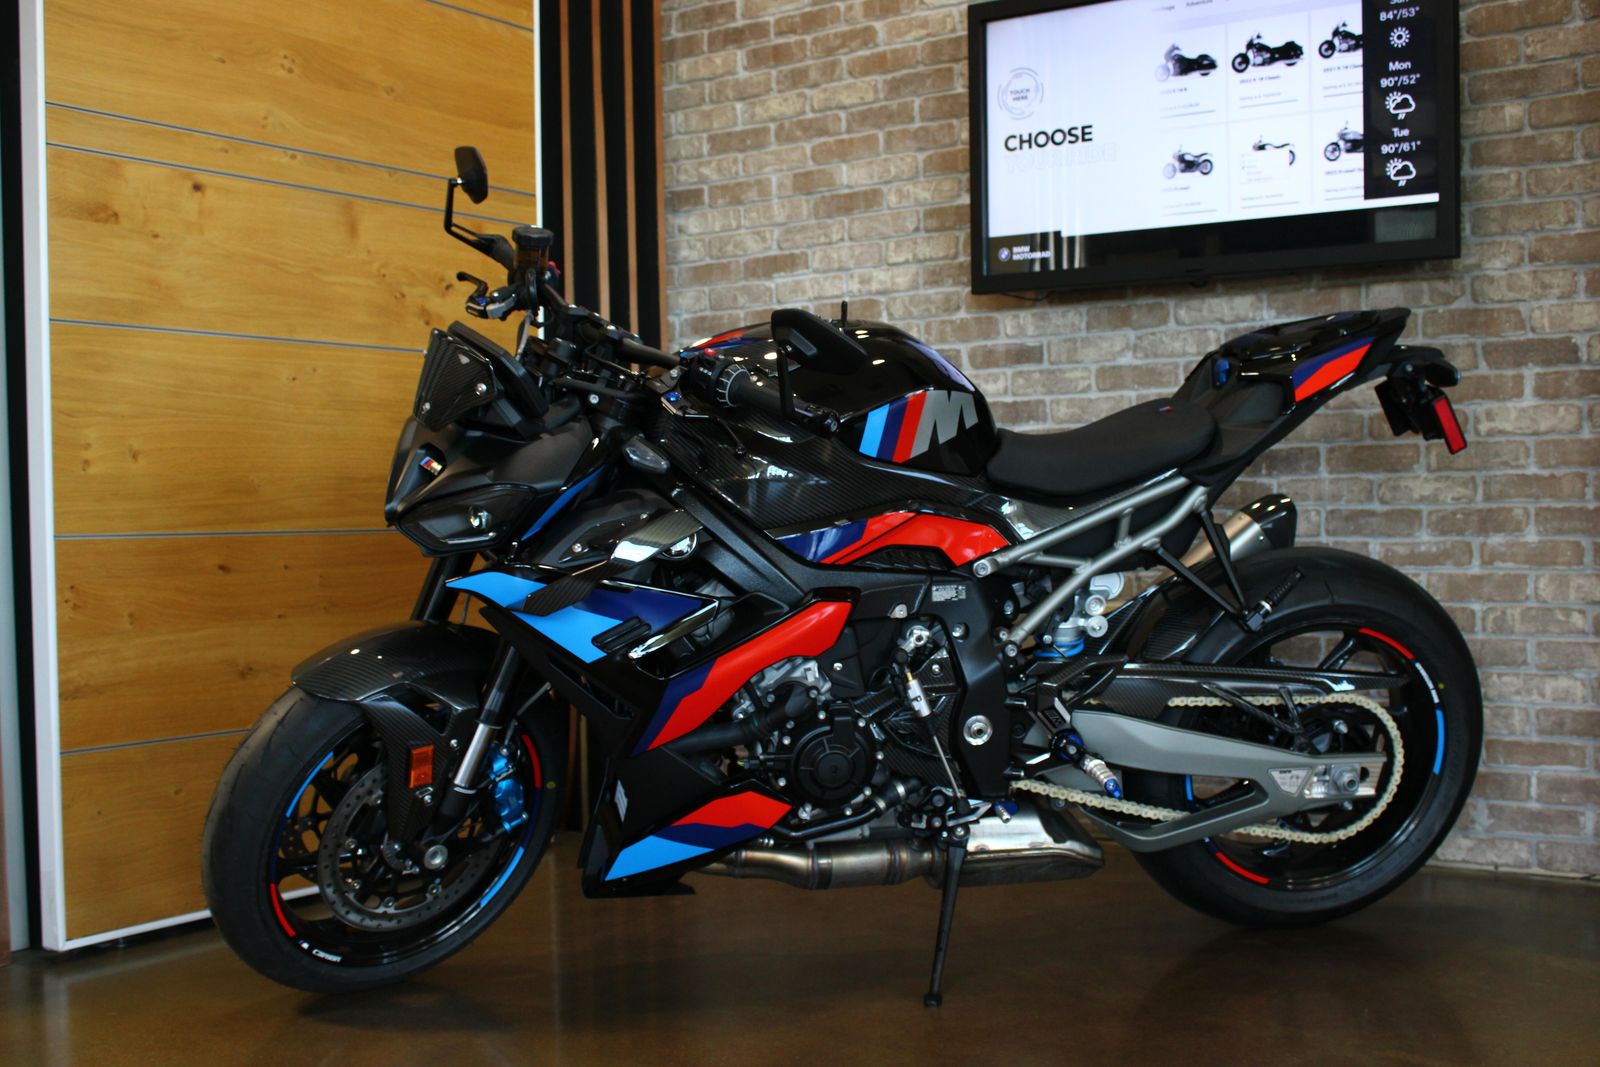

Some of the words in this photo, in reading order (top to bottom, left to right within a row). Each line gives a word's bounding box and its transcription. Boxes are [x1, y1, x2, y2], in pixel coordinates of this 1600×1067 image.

[1389, 61, 1411, 72] Mon
[1004, 124, 1093, 152] CHOOSE
[1392, 127, 1410, 138] Tue
[910, 389, 979, 459] M
